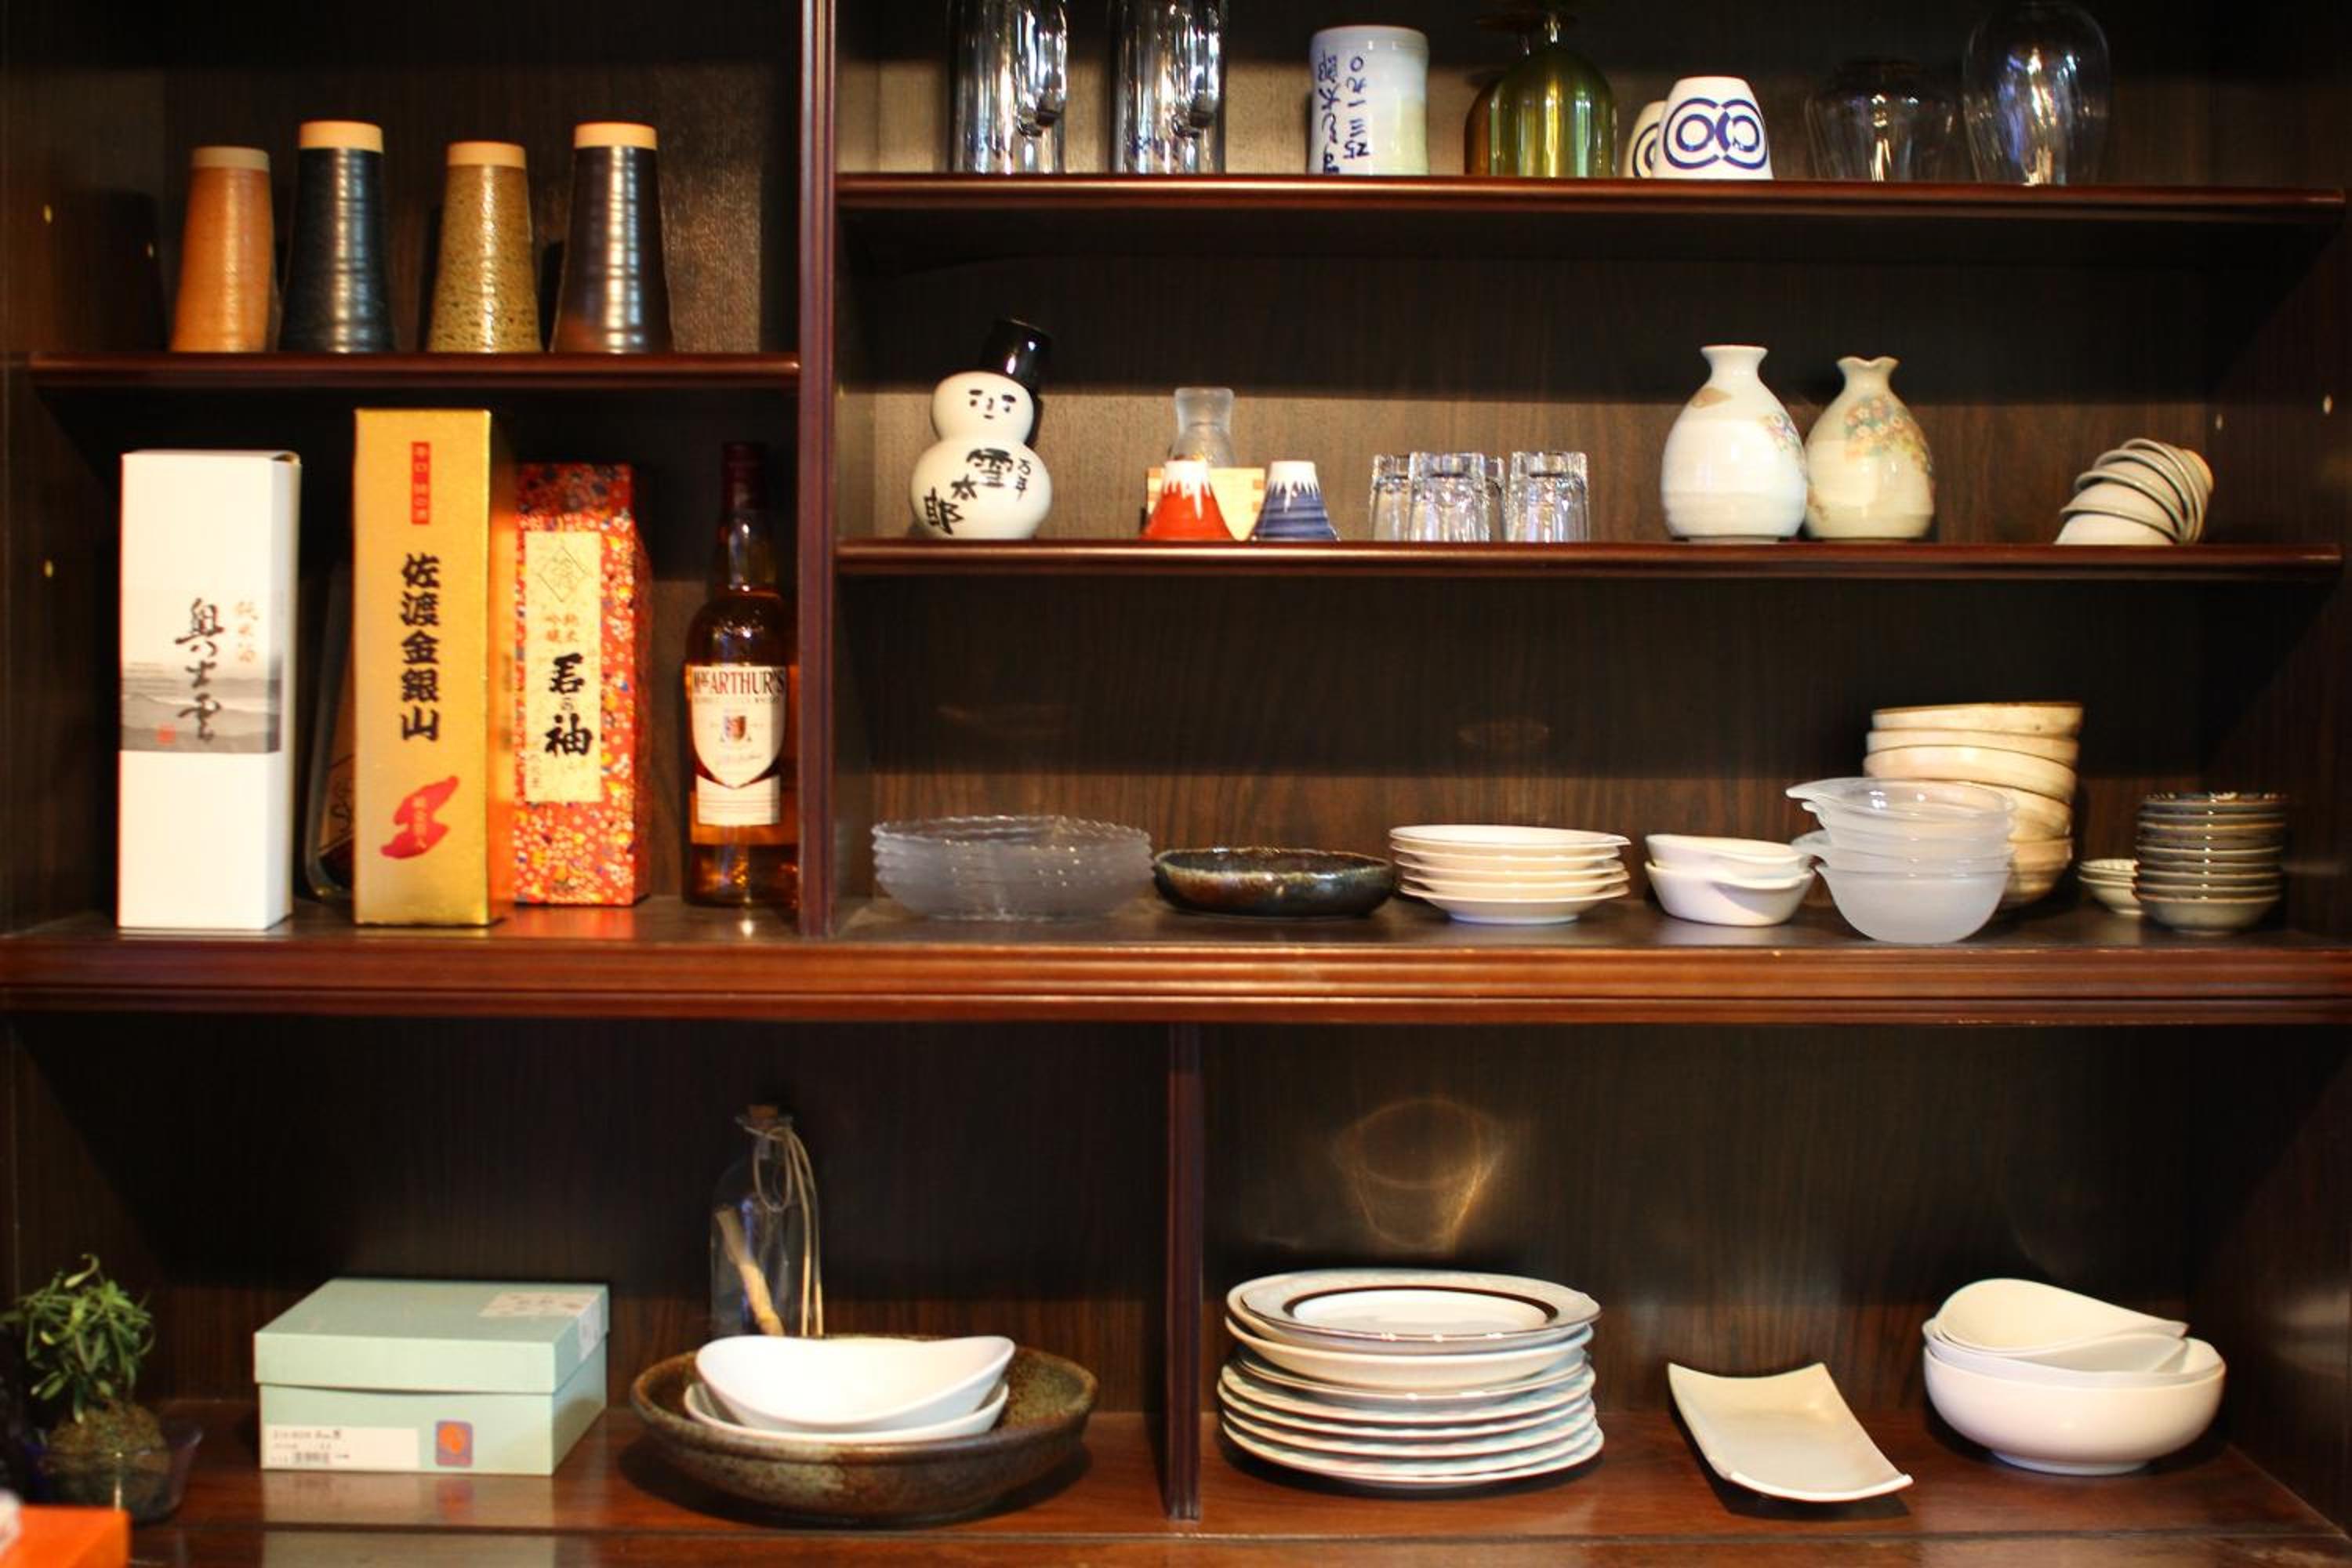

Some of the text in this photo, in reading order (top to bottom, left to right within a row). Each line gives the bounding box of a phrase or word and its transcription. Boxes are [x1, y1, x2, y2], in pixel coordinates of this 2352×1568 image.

[401, 551, 441, 742] 佐渡金銀山
